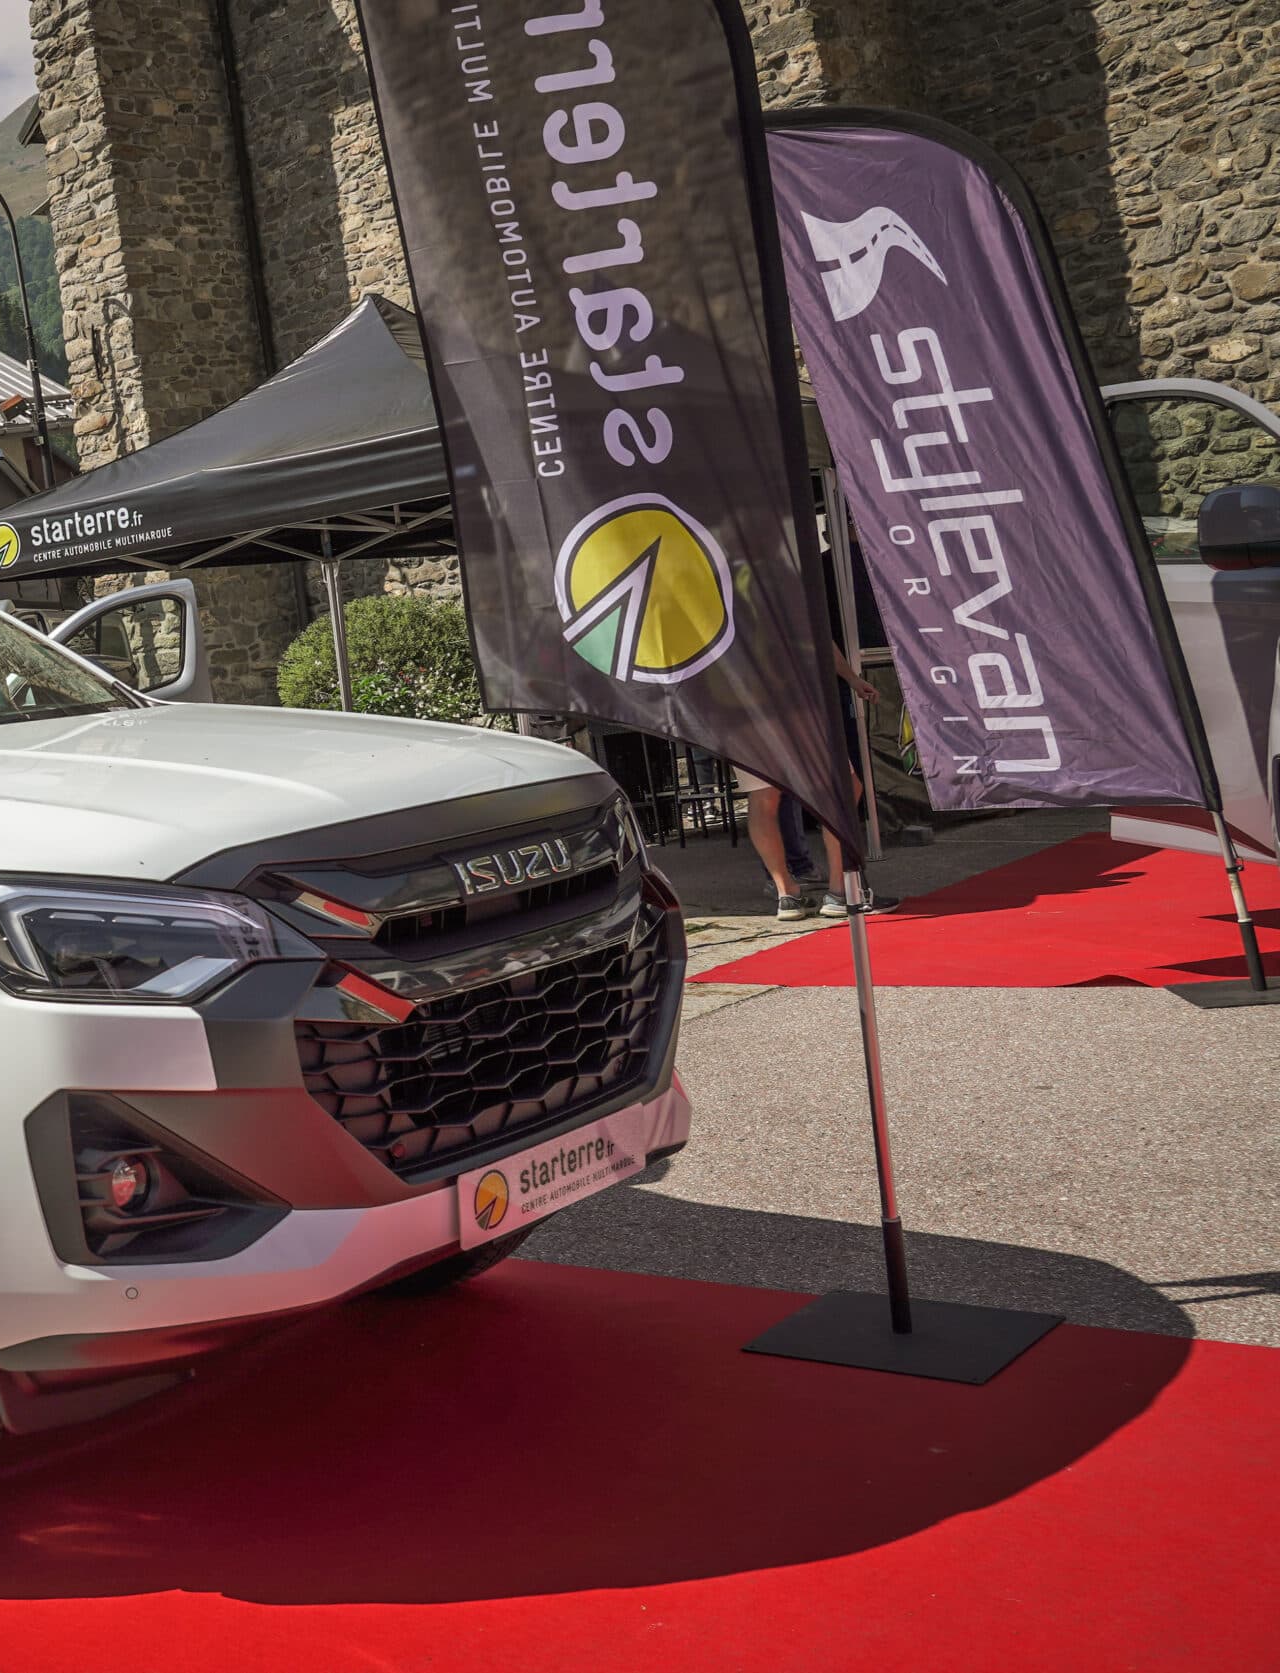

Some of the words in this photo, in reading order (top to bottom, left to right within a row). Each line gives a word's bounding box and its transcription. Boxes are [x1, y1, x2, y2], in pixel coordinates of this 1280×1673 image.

[30, 507, 144, 546] starterre.fr
[33, 549, 62, 563] CENTRE
[64, 540, 113, 557] AUTOMOBILE
[115, 526, 173, 547] MULTIMARQUE
[870, 326, 1062, 775] stylevan
[888, 524, 984, 776] ORIGIN
[454, 838, 572, 895] ISUZU
[520, 1137, 615, 1194] starterre.fr
[521, 1194, 548, 1214] CENTRE
[549, 1177, 591, 1202] AUTOMOBILE
[592, 1154, 636, 1183] MULTIMARQUE
